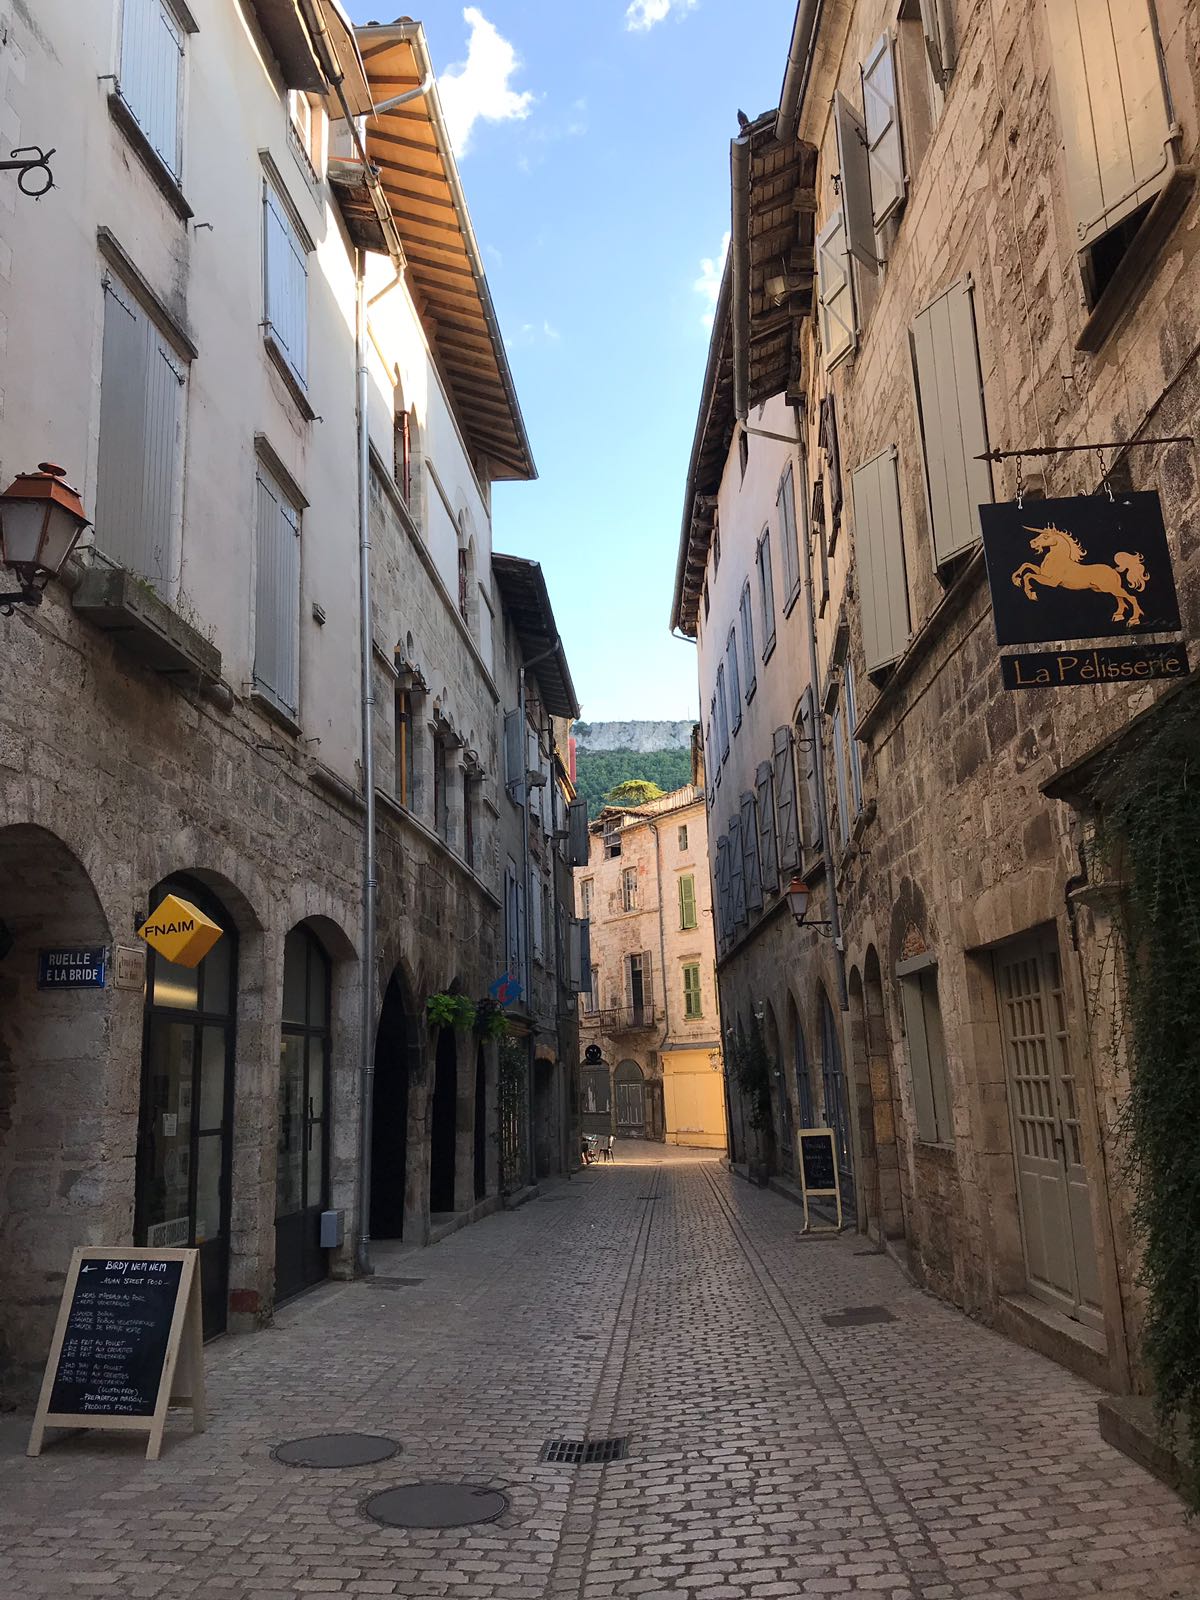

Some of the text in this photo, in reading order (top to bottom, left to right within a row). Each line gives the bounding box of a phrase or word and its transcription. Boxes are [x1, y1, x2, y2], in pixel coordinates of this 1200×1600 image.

[1013, 652, 1181, 685] La Pélisserie
[145, 920, 194, 938] FNAIM
[49, 953, 91, 966] RUELLE
[54, 969, 67, 981] LA
[131, 1262, 147, 1271] NEM
[149, 1263, 167, 1272] NEM
